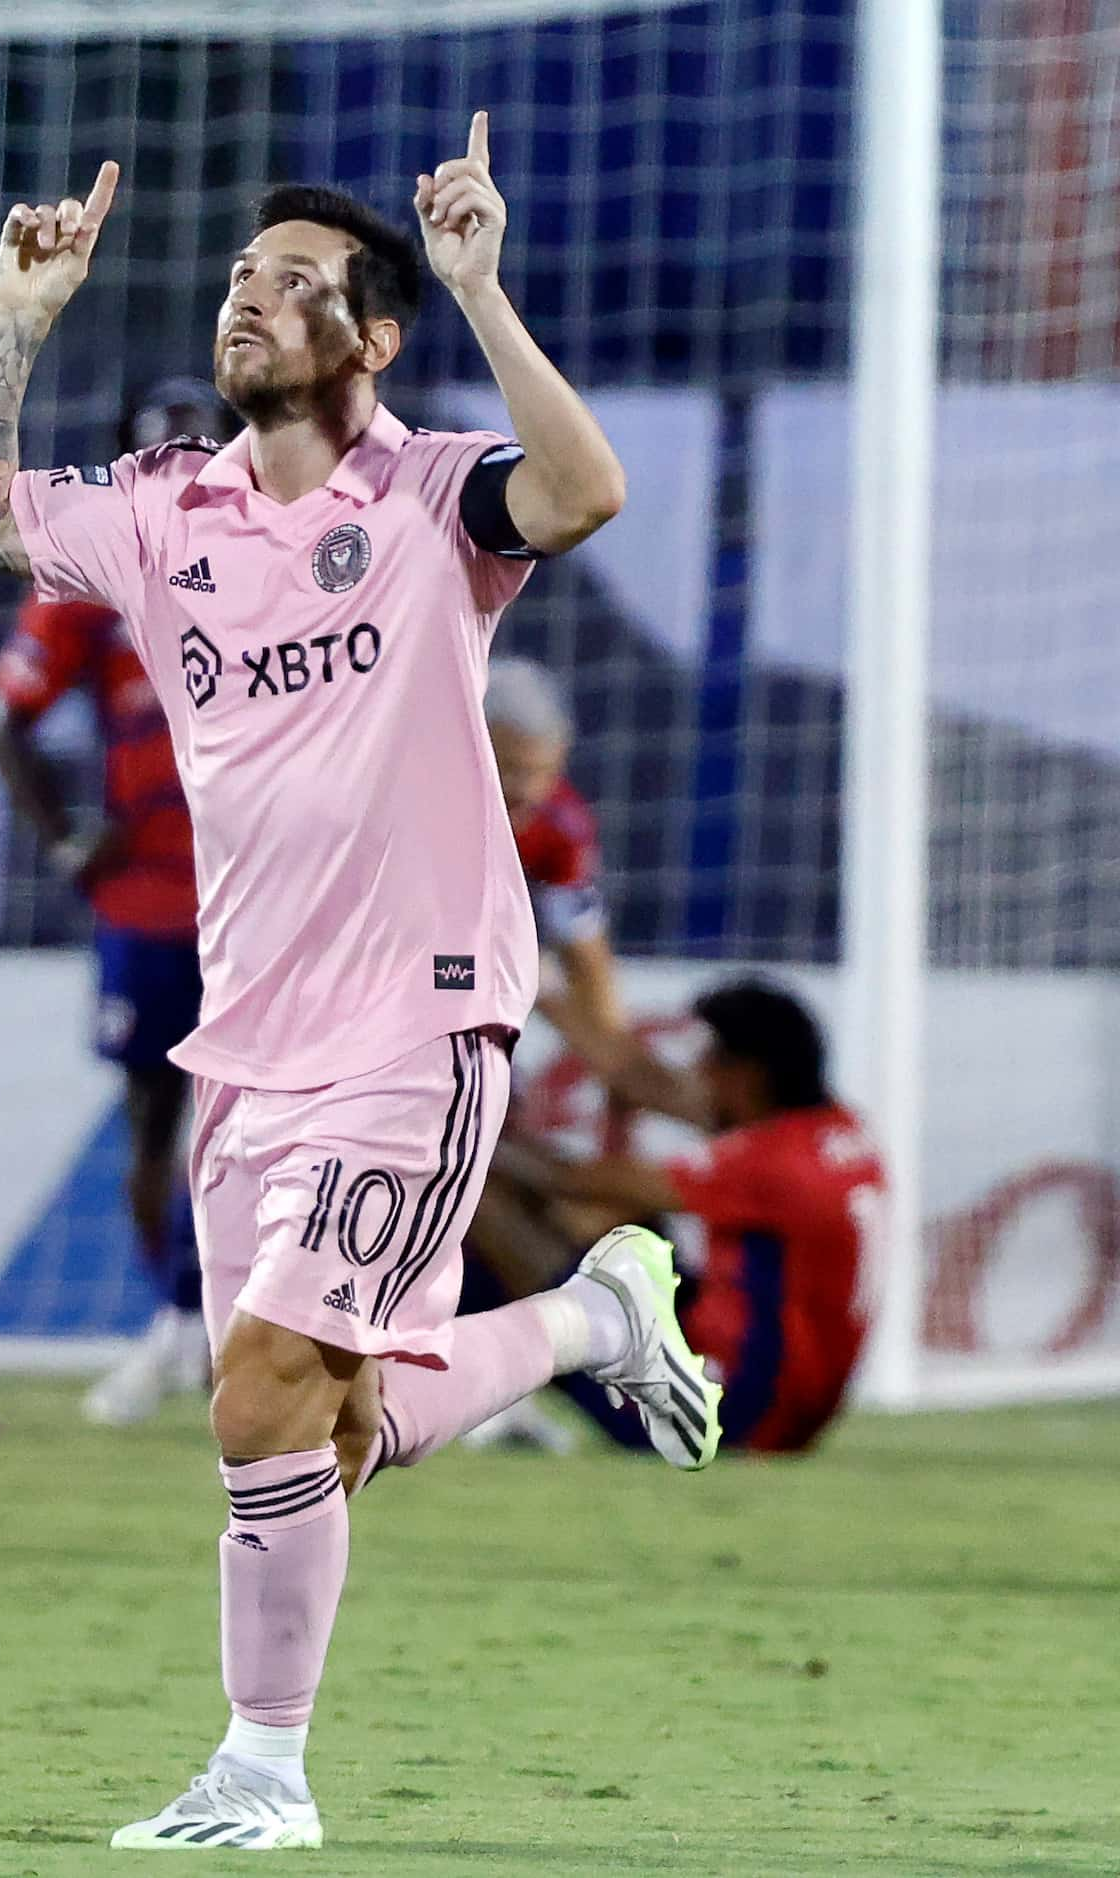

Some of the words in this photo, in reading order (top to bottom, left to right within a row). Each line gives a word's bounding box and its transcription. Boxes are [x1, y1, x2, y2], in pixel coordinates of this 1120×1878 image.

[169, 574, 216, 594] adidas
[241, 622, 381, 698] XBTO
[299, 1157, 406, 1266] 10
